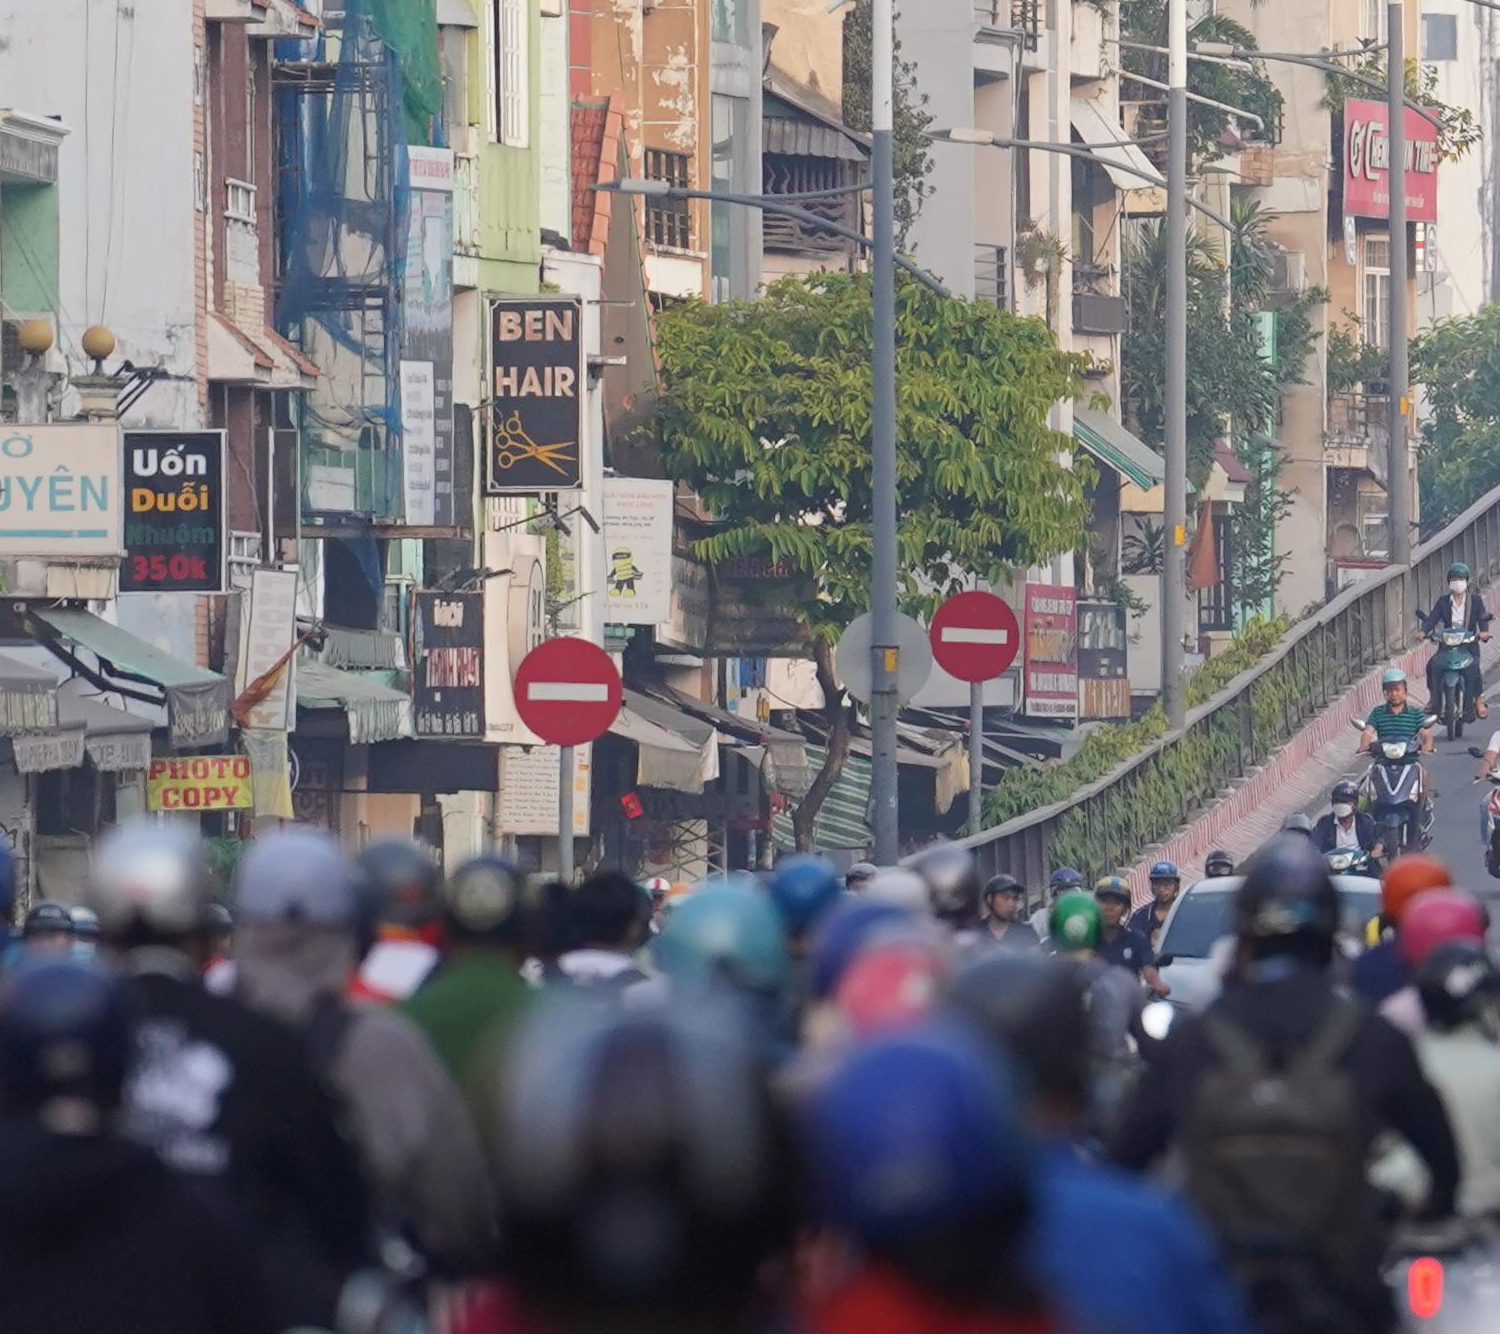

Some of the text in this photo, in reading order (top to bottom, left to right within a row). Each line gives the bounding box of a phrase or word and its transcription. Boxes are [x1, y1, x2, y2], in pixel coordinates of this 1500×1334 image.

[499, 310, 572, 342] BEN
[495, 366, 575, 397] HAIR
[133, 444, 207, 477] Uốn
[132, 481, 209, 513] Duỗi
[149, 757, 250, 780] PHOTO
[162, 787, 240, 809] COPY
